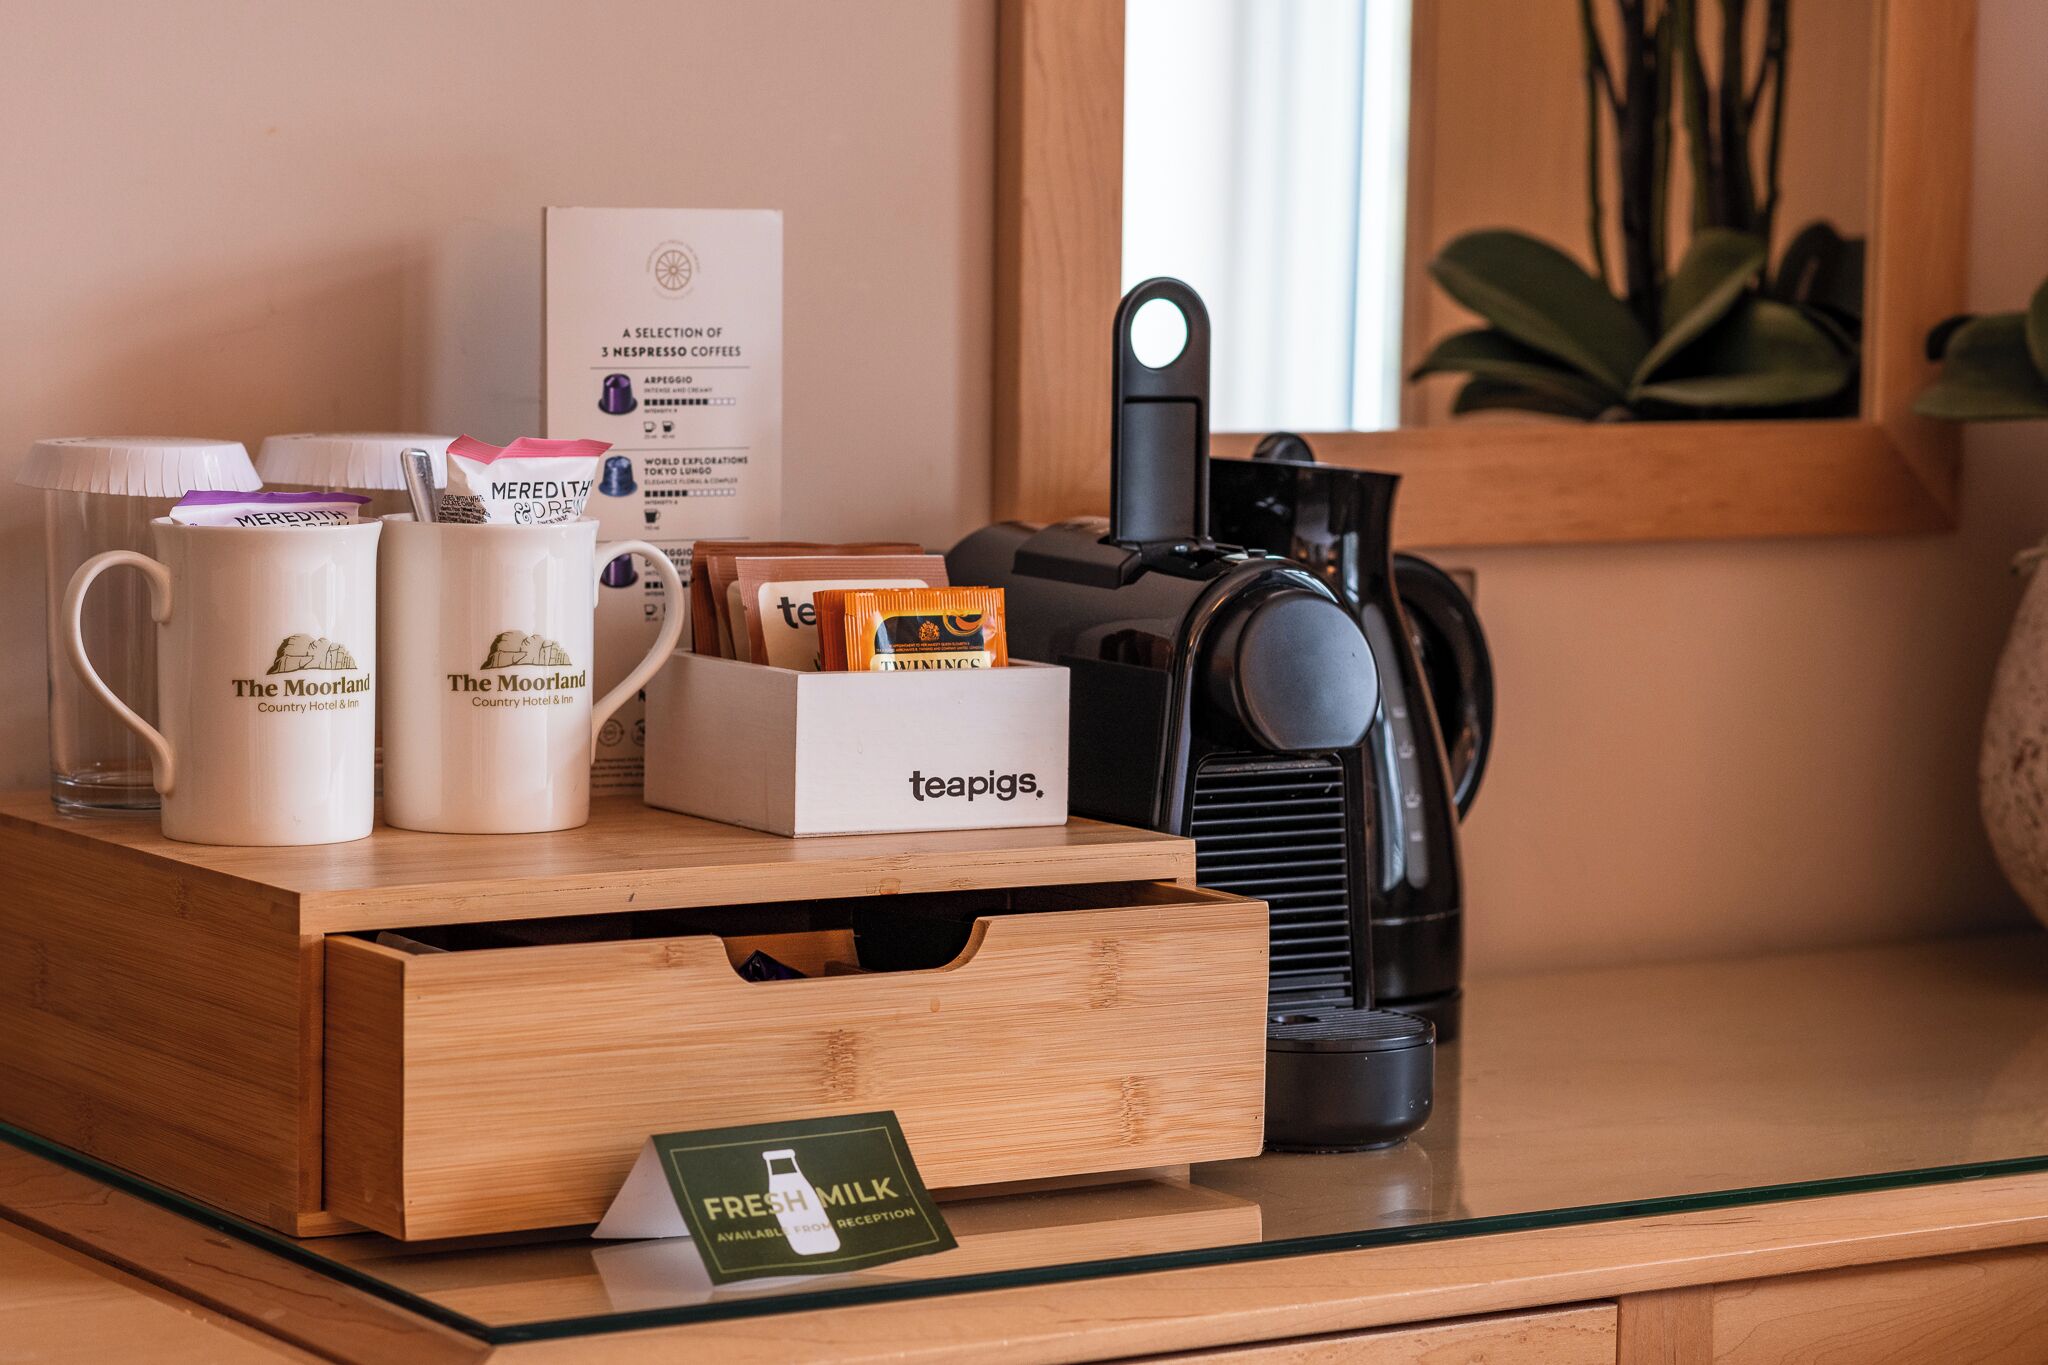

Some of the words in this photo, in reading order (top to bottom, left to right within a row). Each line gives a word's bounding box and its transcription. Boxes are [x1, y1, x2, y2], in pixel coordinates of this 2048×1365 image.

[623, 328, 631, 338] A
[635, 327, 704, 338] SELECTION
[707, 327, 723, 338] OF
[601, 347, 609, 357] 3
[613, 347, 687, 357] NESPRESSO
[691, 346, 741, 357] COFFEES
[644, 376, 693, 384] ARPEGGIO
[644, 458, 680, 466] WORLD
[683, 456, 748, 465] EXPLORATIONS
[644, 467, 677, 476] TOKYO
[680, 467, 712, 475] LUNGO
[491, 480, 590, 500] MEREDITH
[234, 510, 348, 527] MEREDITH
[231, 679, 278, 697] The
[283, 673, 370, 697] Moorland
[447, 673, 492, 692] The
[497, 669, 586, 692] Moorland
[257, 702, 307, 714] Country
[309, 699, 338, 711] Hotel
[339, 700, 346, 709] &
[347, 698, 359, 708] Inn
[472, 696, 520, 709] Country
[522, 695, 551, 706] Hotel
[553, 695, 559, 705] &
[561, 694, 574, 704] Inn
[908, 769, 1045, 802] teapigs.
[702, 1189, 810, 1221] FRESH
[815, 1176, 899, 1208] MILK
[717, 1226, 789, 1243] AVAILABLE
[793, 1221, 834, 1235] FROM
[837, 1207, 916, 1229] RECEPTION
